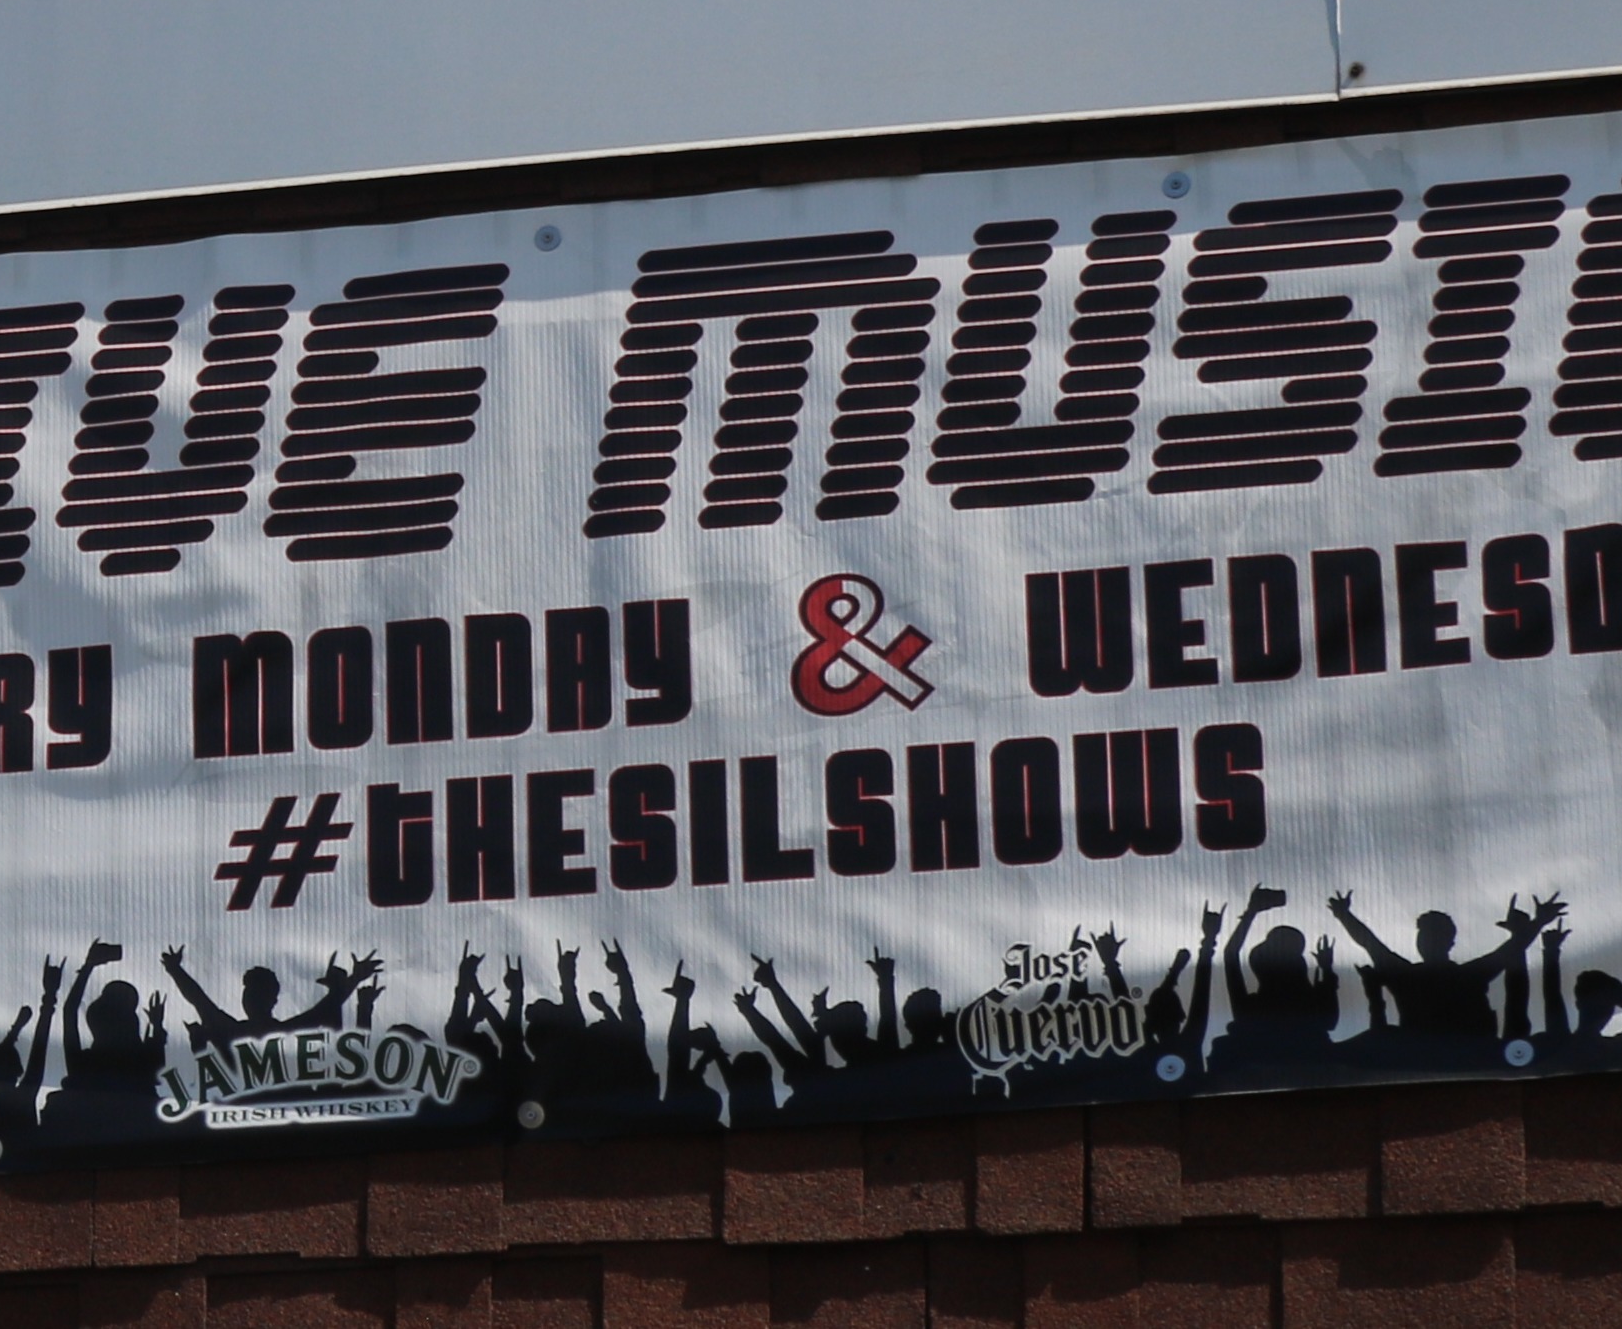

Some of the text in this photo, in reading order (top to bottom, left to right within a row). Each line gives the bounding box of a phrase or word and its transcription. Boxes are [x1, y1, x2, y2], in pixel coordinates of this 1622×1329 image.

[192, 597, 692, 760] MONDAY
[790, 572, 935, 717] &
[1024, 522, 1622, 699] WEDNESD
[213, 722, 1267, 912] #THESILSHOWS
[160, 1031, 462, 1117] JAMESON
[957, 988, 1145, 1076] Cuervo
[210, 1098, 415, 1124] IRISH WHISKEY
